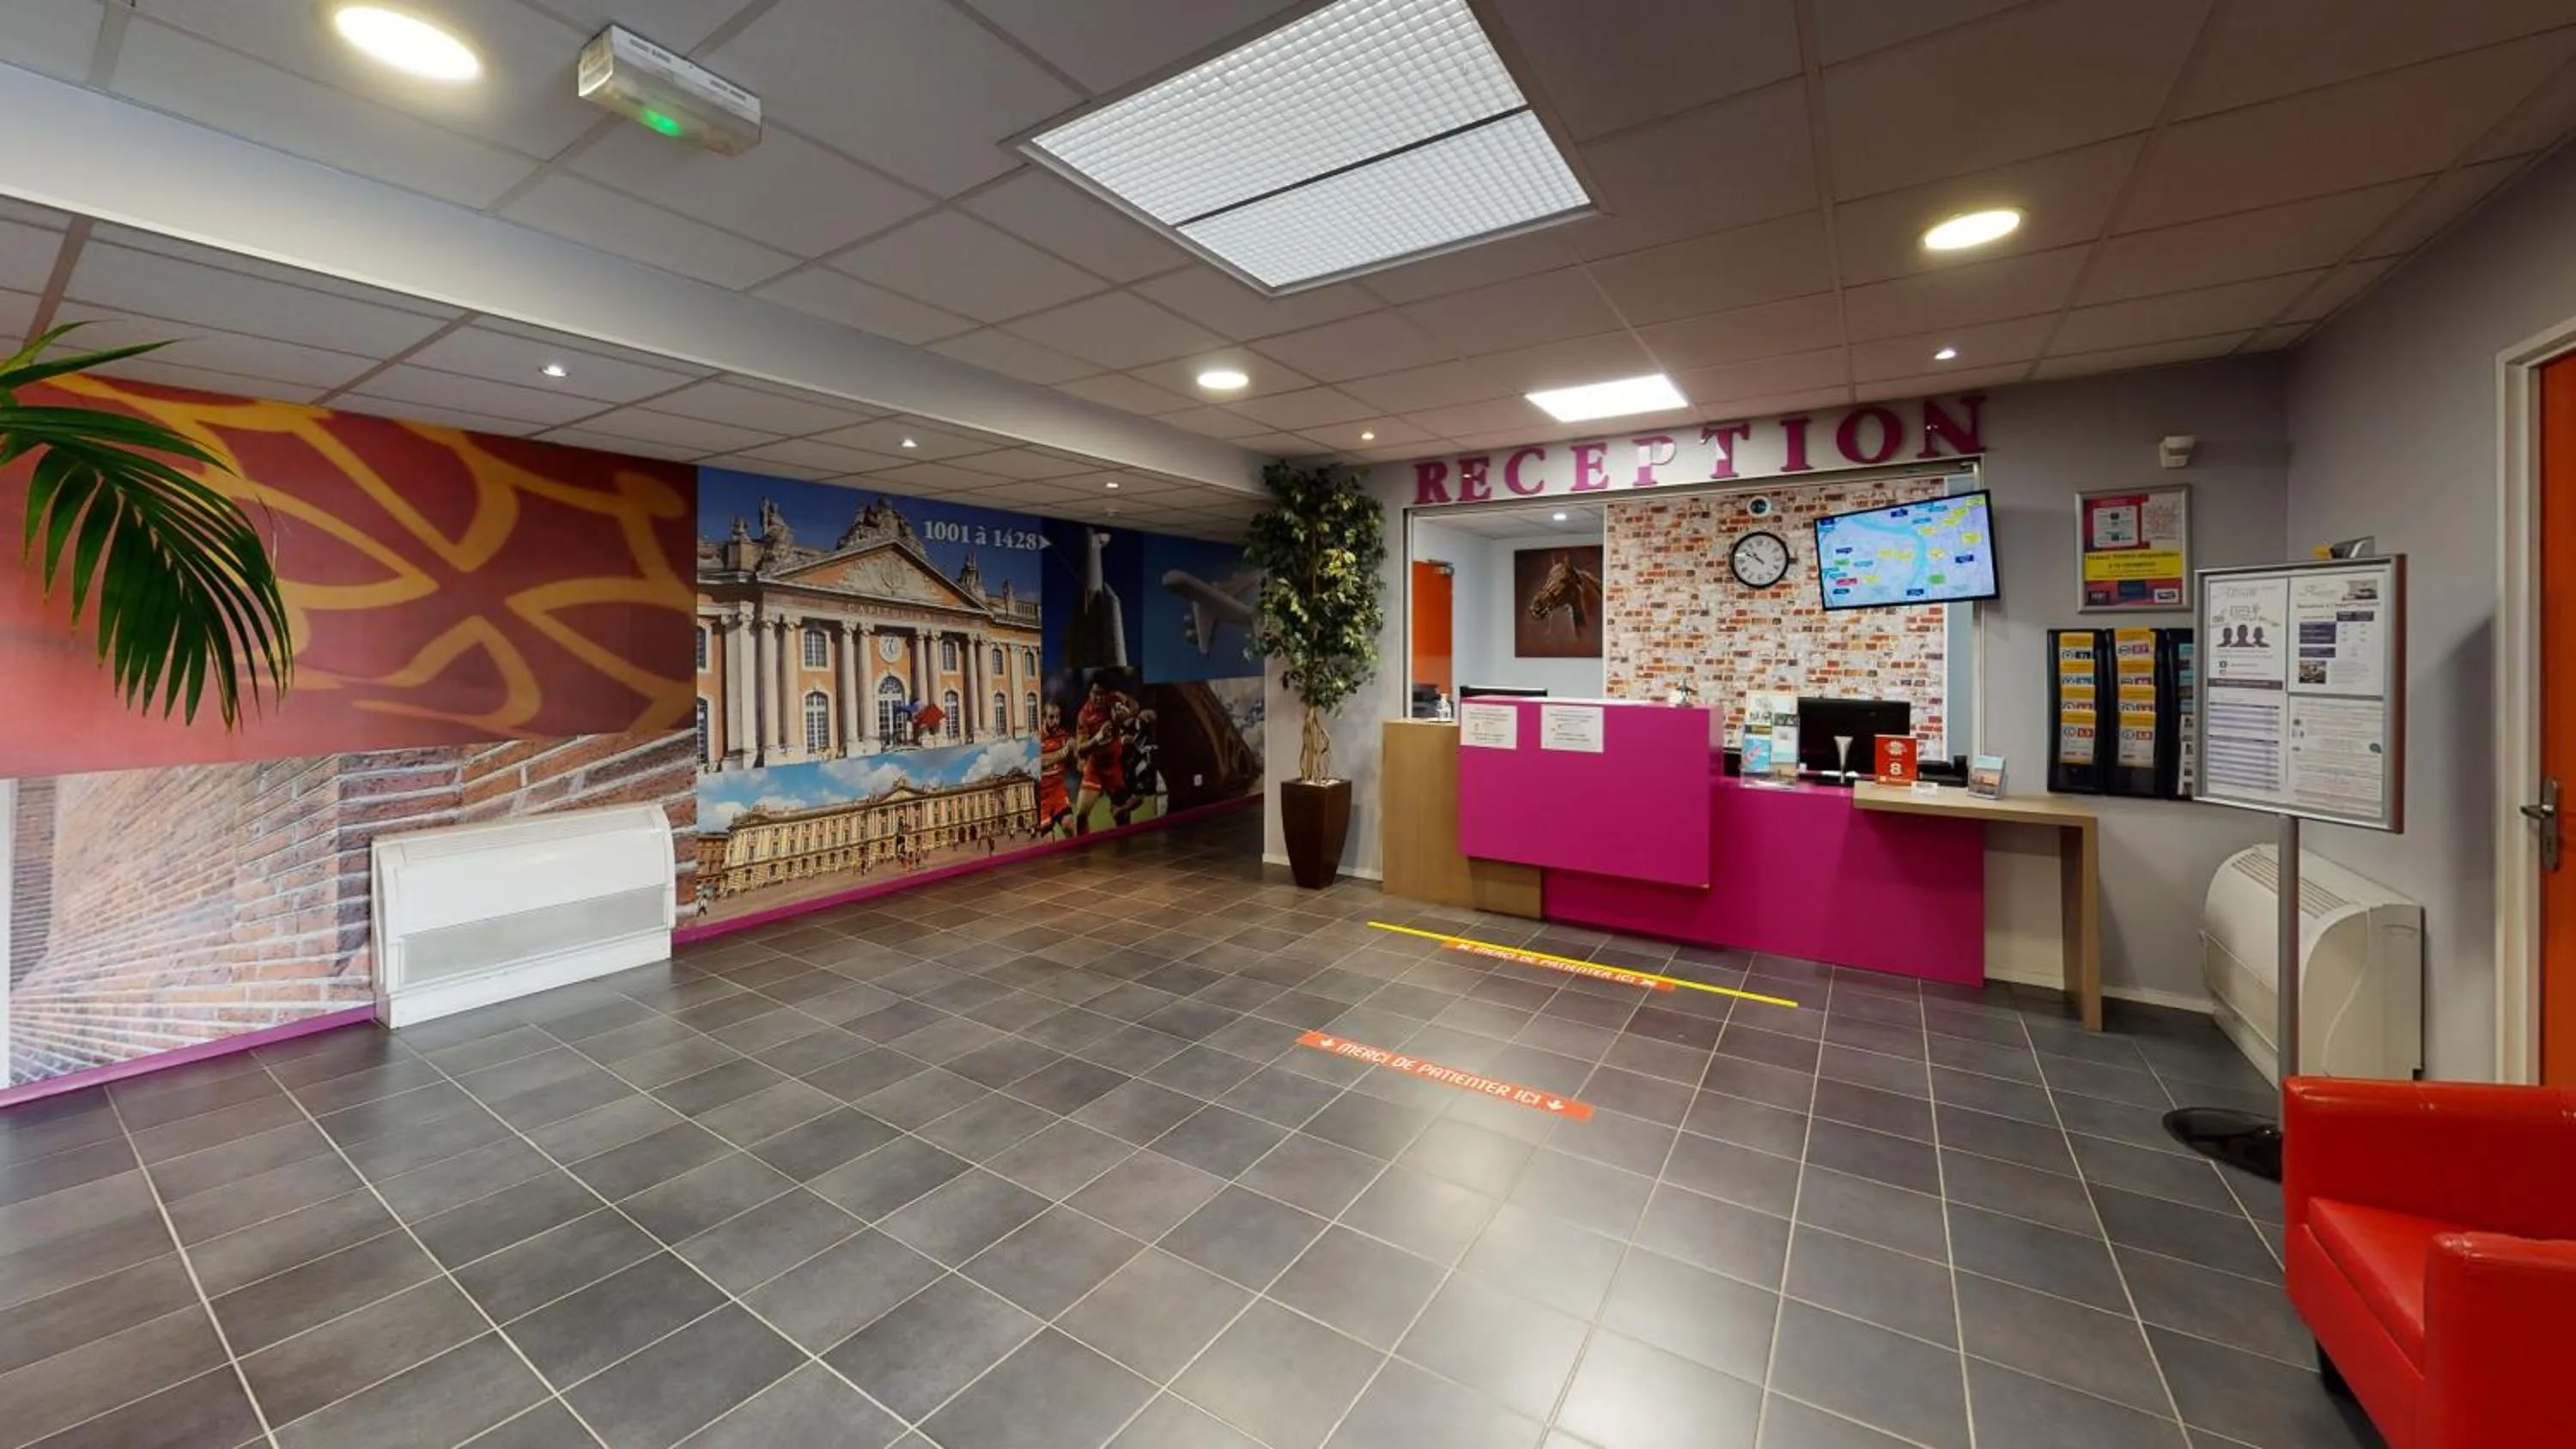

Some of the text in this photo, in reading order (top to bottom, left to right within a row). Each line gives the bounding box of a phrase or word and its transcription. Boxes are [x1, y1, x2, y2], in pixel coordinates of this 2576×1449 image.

[1415, 396, 1986, 504] RECEPTION
[924, 520, 1036, 550] 1001 à 1428
[1337, 1042, 1541, 1106] MERCI DE PATIENTER ICI
